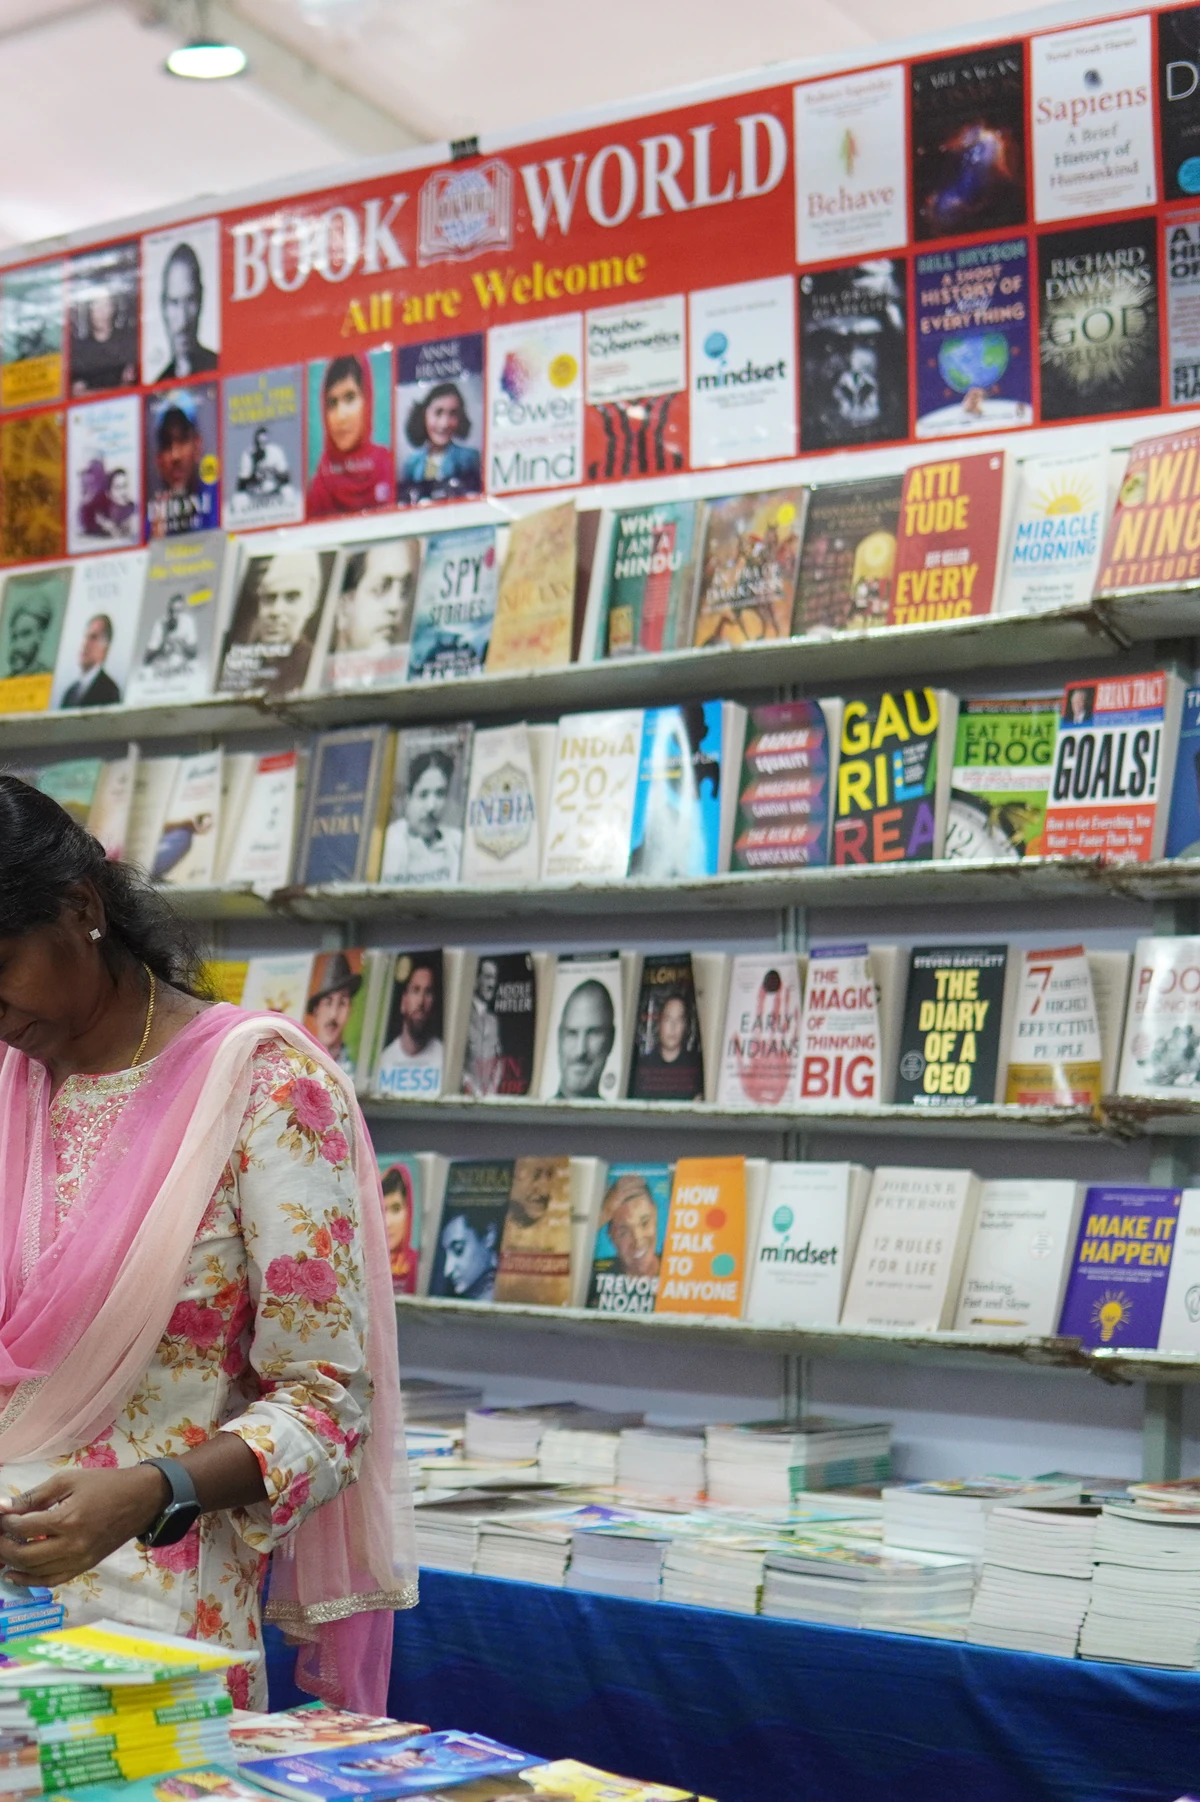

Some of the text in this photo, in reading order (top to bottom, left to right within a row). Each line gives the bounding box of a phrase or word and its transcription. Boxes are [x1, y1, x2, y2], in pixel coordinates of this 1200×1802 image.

[1035, 85, 1147, 126] Sapiens
[1081, 122, 1118, 143] Brief
[1055, 139, 1131, 169] History of
[1049, 160, 1140, 189] Humankind
[230, 111, 789, 301] BOOK WORLD
[807, 183, 895, 220] Behave
[1051, 247, 1146, 278] RICHARD
[340, 251, 648, 338] All are Welcome
[1000, 274, 1022, 295] OF
[1045, 264, 1152, 301] DAWKINS
[920, 302, 1026, 335] EVERYTHING
[1050, 305, 1147, 348] GOD
[590, 331, 681, 359] Cybernetics
[696, 357, 787, 393] mindset
[493, 396, 577, 429] Power
[491, 446, 576, 487] Mind
[906, 461, 961, 503] ATTI
[621, 512, 667, 535] WHY
[904, 495, 970, 538] TUDE
[1015, 511, 1100, 543] MIRACLE
[1012, 537, 1098, 565] MORNING
[440, 554, 484, 600] SPY
[614, 551, 683, 581] HINDU
[1100, 552, 1200, 588] ATTITUDE
[895, 563, 979, 606] EVERY
[1095, 676, 1165, 711] BRIAN TRACY
[840, 687, 940, 756] GAU
[964, 722, 1054, 742] EAT THAT
[560, 732, 637, 761] INDIA
[963, 740, 1051, 766] FROG
[1053, 729, 1161, 801] GOALS!
[469, 792, 536, 828] INDIA
[913, 954, 1005, 969] STEVEN BARTLETT
[813, 968, 839, 985] THE
[934, 968, 980, 1001] THE
[1027, 965, 1054, 1016] 7
[494, 997, 532, 1014] HITLER
[808, 987, 873, 1011] MAGIC
[740, 1010, 793, 1034] EARLY
[807, 1016, 825, 1031] OF
[918, 1000, 989, 1032] DIARY
[727, 1039, 799, 1059] INDIANS
[806, 1035, 876, 1051] THINKING
[924, 1031, 976, 1063] OF A
[379, 1066, 440, 1093] MESSI
[800, 1055, 875, 1099] BIG
[922, 1063, 972, 1095] CEO
[676, 1185, 719, 1206] HOW
[880, 1180, 943, 1195] JORDAN
[873, 1197, 958, 1211] PETERSON
[674, 1210, 699, 1229] TO
[1085, 1214, 1178, 1240] MAKE IT
[670, 1233, 714, 1253] TALK
[760, 1239, 839, 1266] mindset
[873, 1236, 944, 1255] 12 RULES
[1079, 1240, 1173, 1268] HAPPEN
[667, 1257, 693, 1276] TO
[867, 1257, 938, 1277] FOR LIFE
[595, 1273, 659, 1295] TREVOR
[662, 1280, 738, 1302] ANYONE
[967, 1279, 1016, 1296] Thinking,
[599, 1293, 654, 1313] NOAH
[962, 1297, 1032, 1311] Fast and Slow
